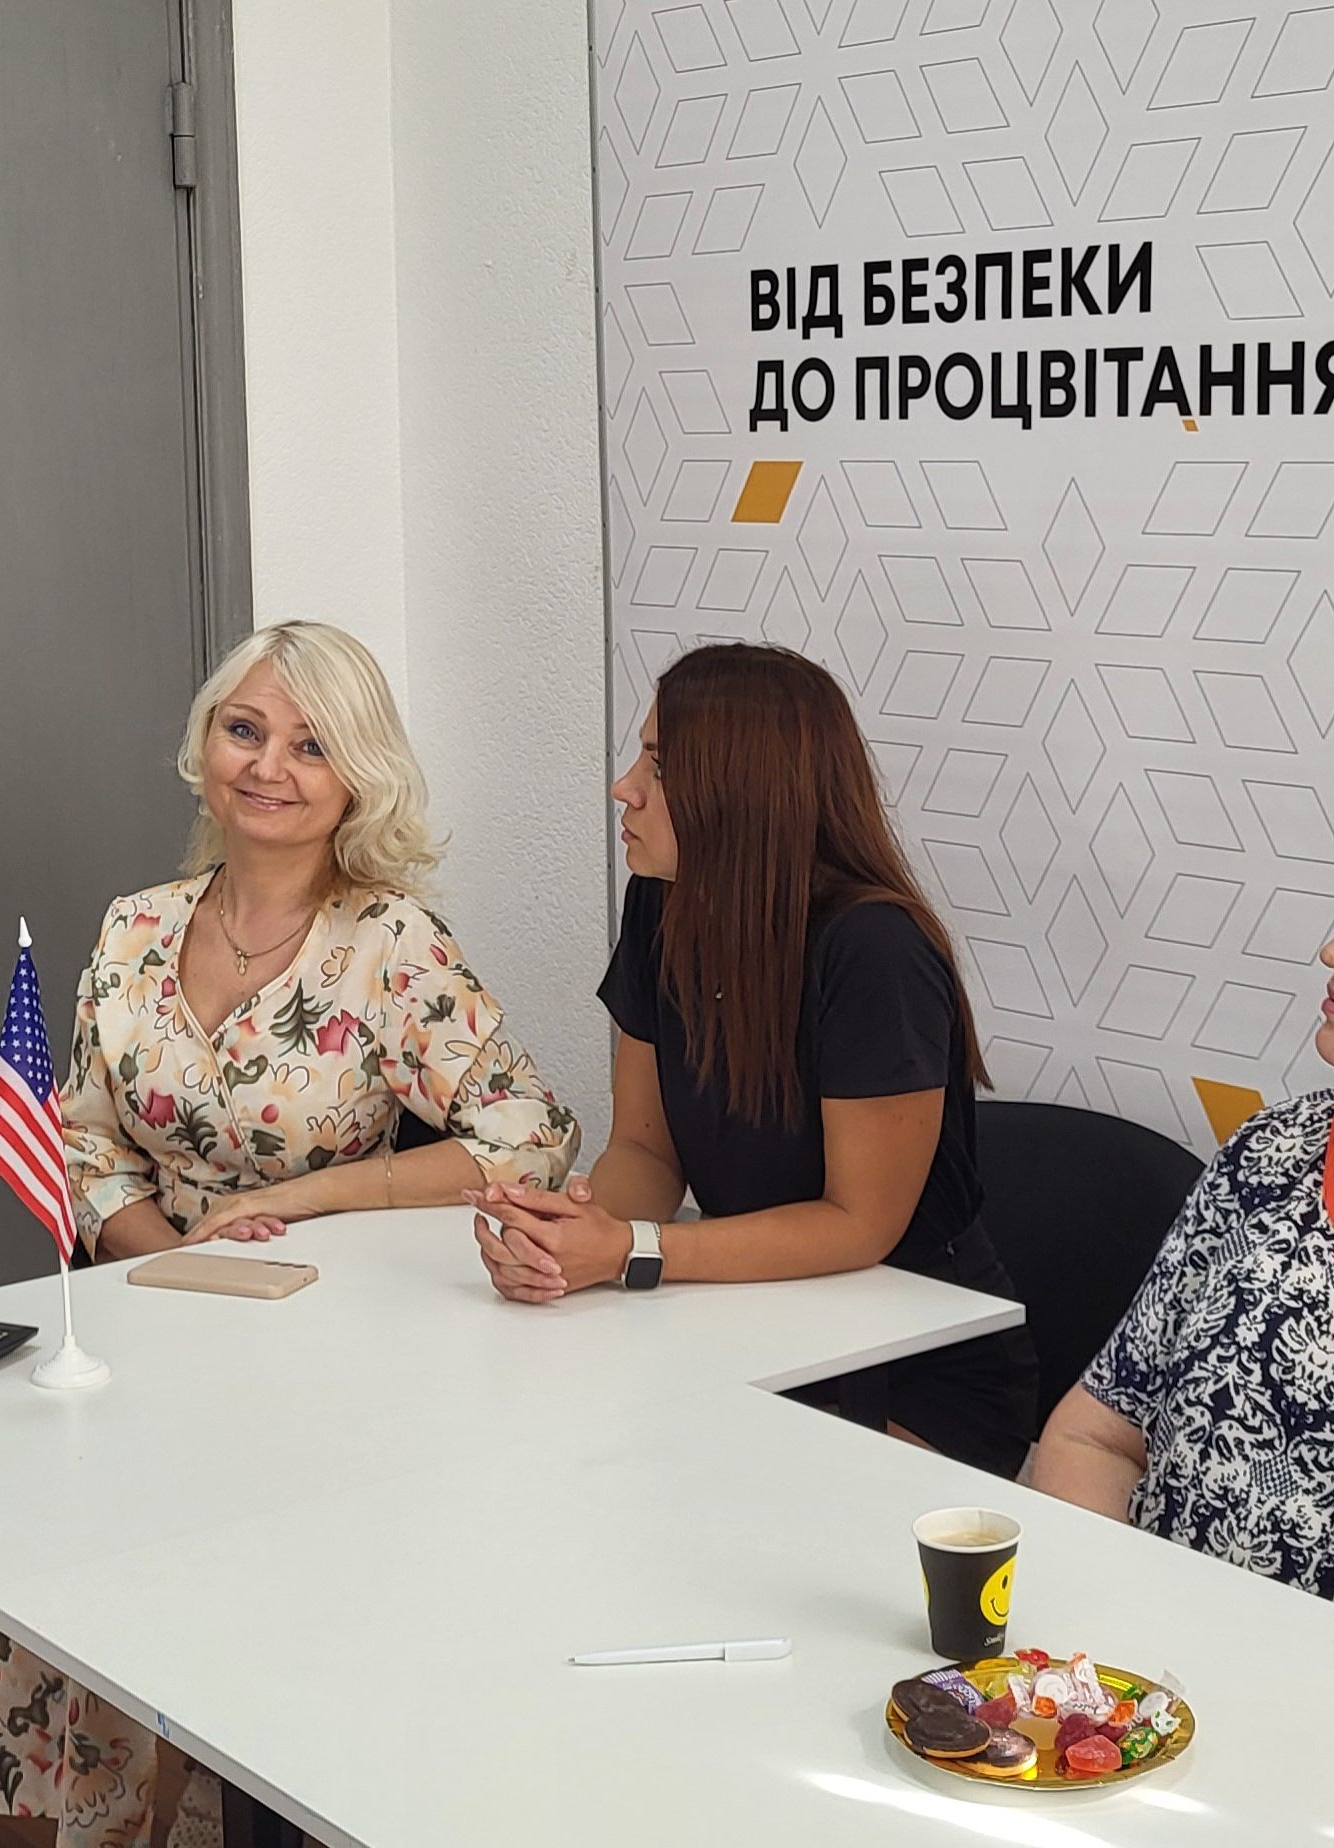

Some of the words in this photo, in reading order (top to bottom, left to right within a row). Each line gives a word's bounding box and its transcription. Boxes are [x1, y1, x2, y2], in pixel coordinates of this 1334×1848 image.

[751, 265, 842, 339] ВІД
[864, 242, 1152, 325] БЕЗПЕКИ
[750, 358, 834, 432] ДО
